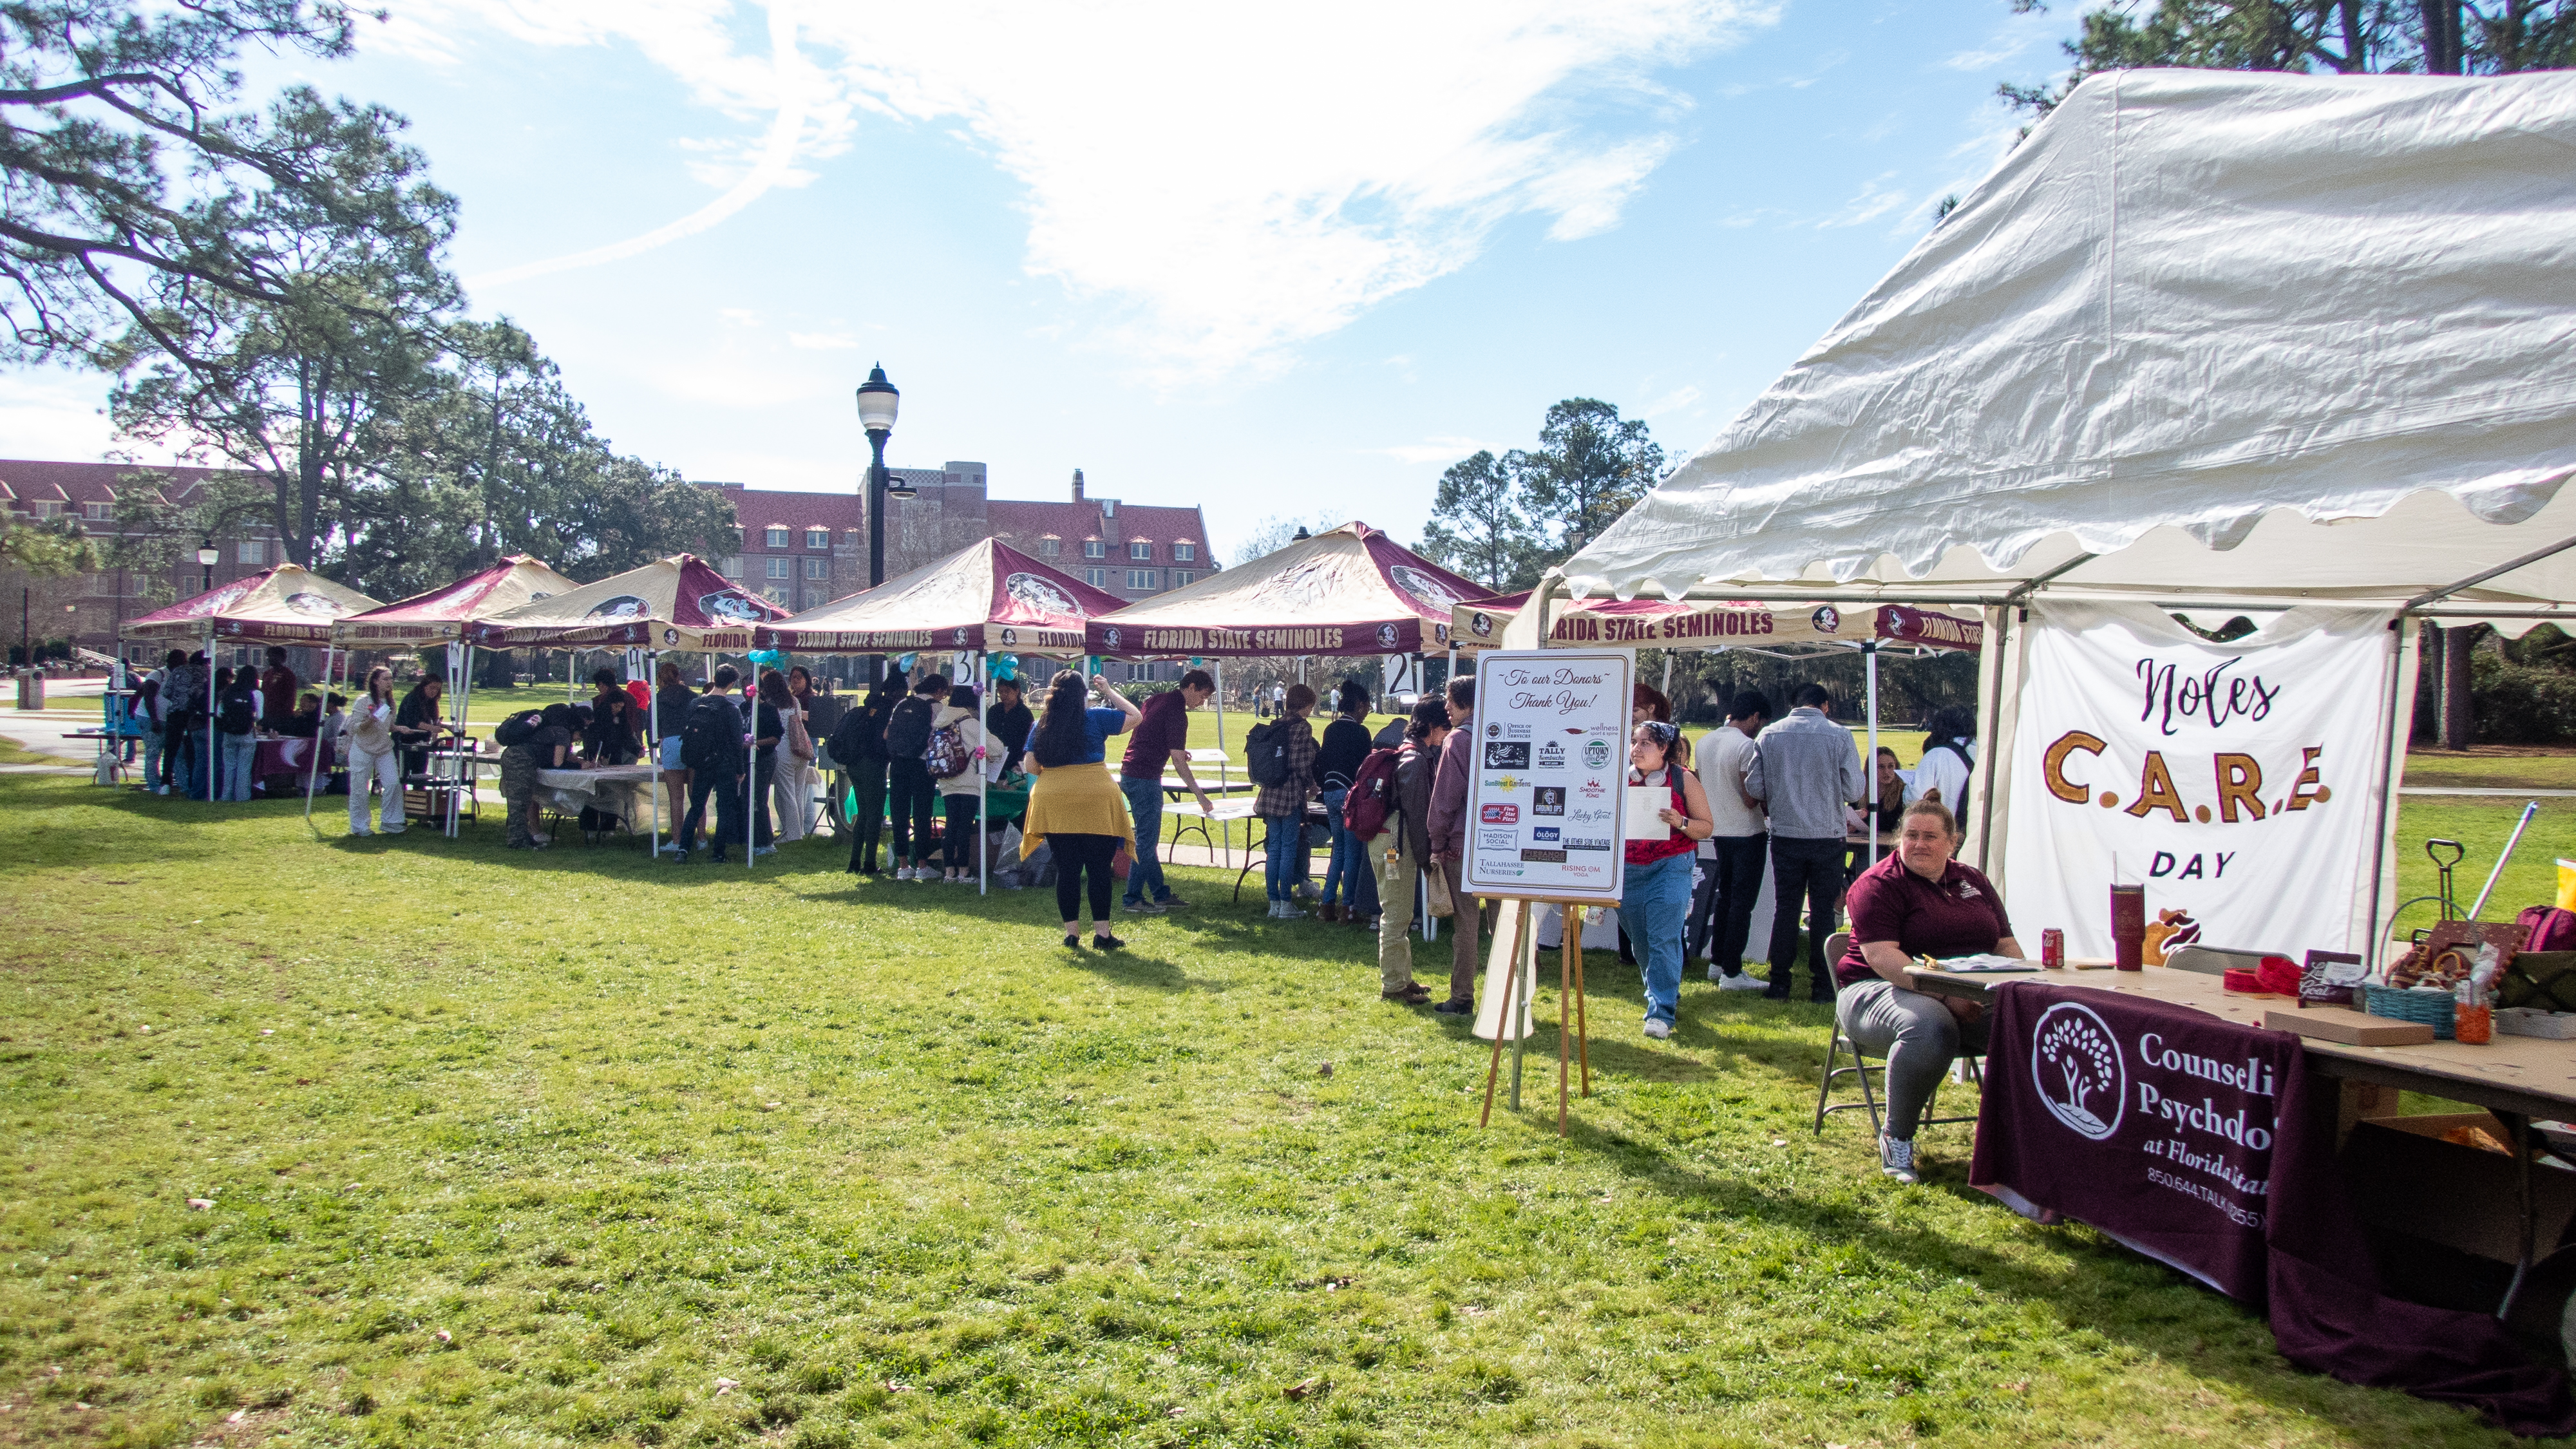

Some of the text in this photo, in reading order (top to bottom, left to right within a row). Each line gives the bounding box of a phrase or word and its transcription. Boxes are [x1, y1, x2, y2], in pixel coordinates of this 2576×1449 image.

[264, 624, 309, 639] FLORIDA
[1604, 618, 1656, 640] STATE
[1663, 612, 1774, 638] SEMINOLES
[1918, 616, 1963, 643] FLORIDA
[702, 633, 748, 649] FLORIDA
[795, 630, 933, 647] FLORIDA STATE SEMINOLES
[1037, 631, 1085, 649] FLORIDA
[1144, 627, 1343, 650] FLORIDA STATE SEMINOLES
[629, 648, 641, 680] 4
[956, 650, 972, 684] 3
[1388, 652, 1412, 695] 2
[1531, 674, 1551, 685] our
[1509, 690, 1598, 715] Thank You!
[2136, 656, 2281, 736] Notes
[1590, 722, 1619, 731] wellness
[1584, 746, 1609, 755] UPTOWN
[1509, 778, 1531, 787] Gardens
[2043, 729, 2332, 824] C.A.R.E.
[1567, 808, 1614, 824] Lucky Goat
[1479, 858, 1525, 868] TALLAHASSEE
[1479, 866, 1516, 876] NURSERIES
[2148, 851, 2237, 880] DAY
[2143, 1139, 2165, 1155] at
[2166, 1139, 2232, 1181] Florida
